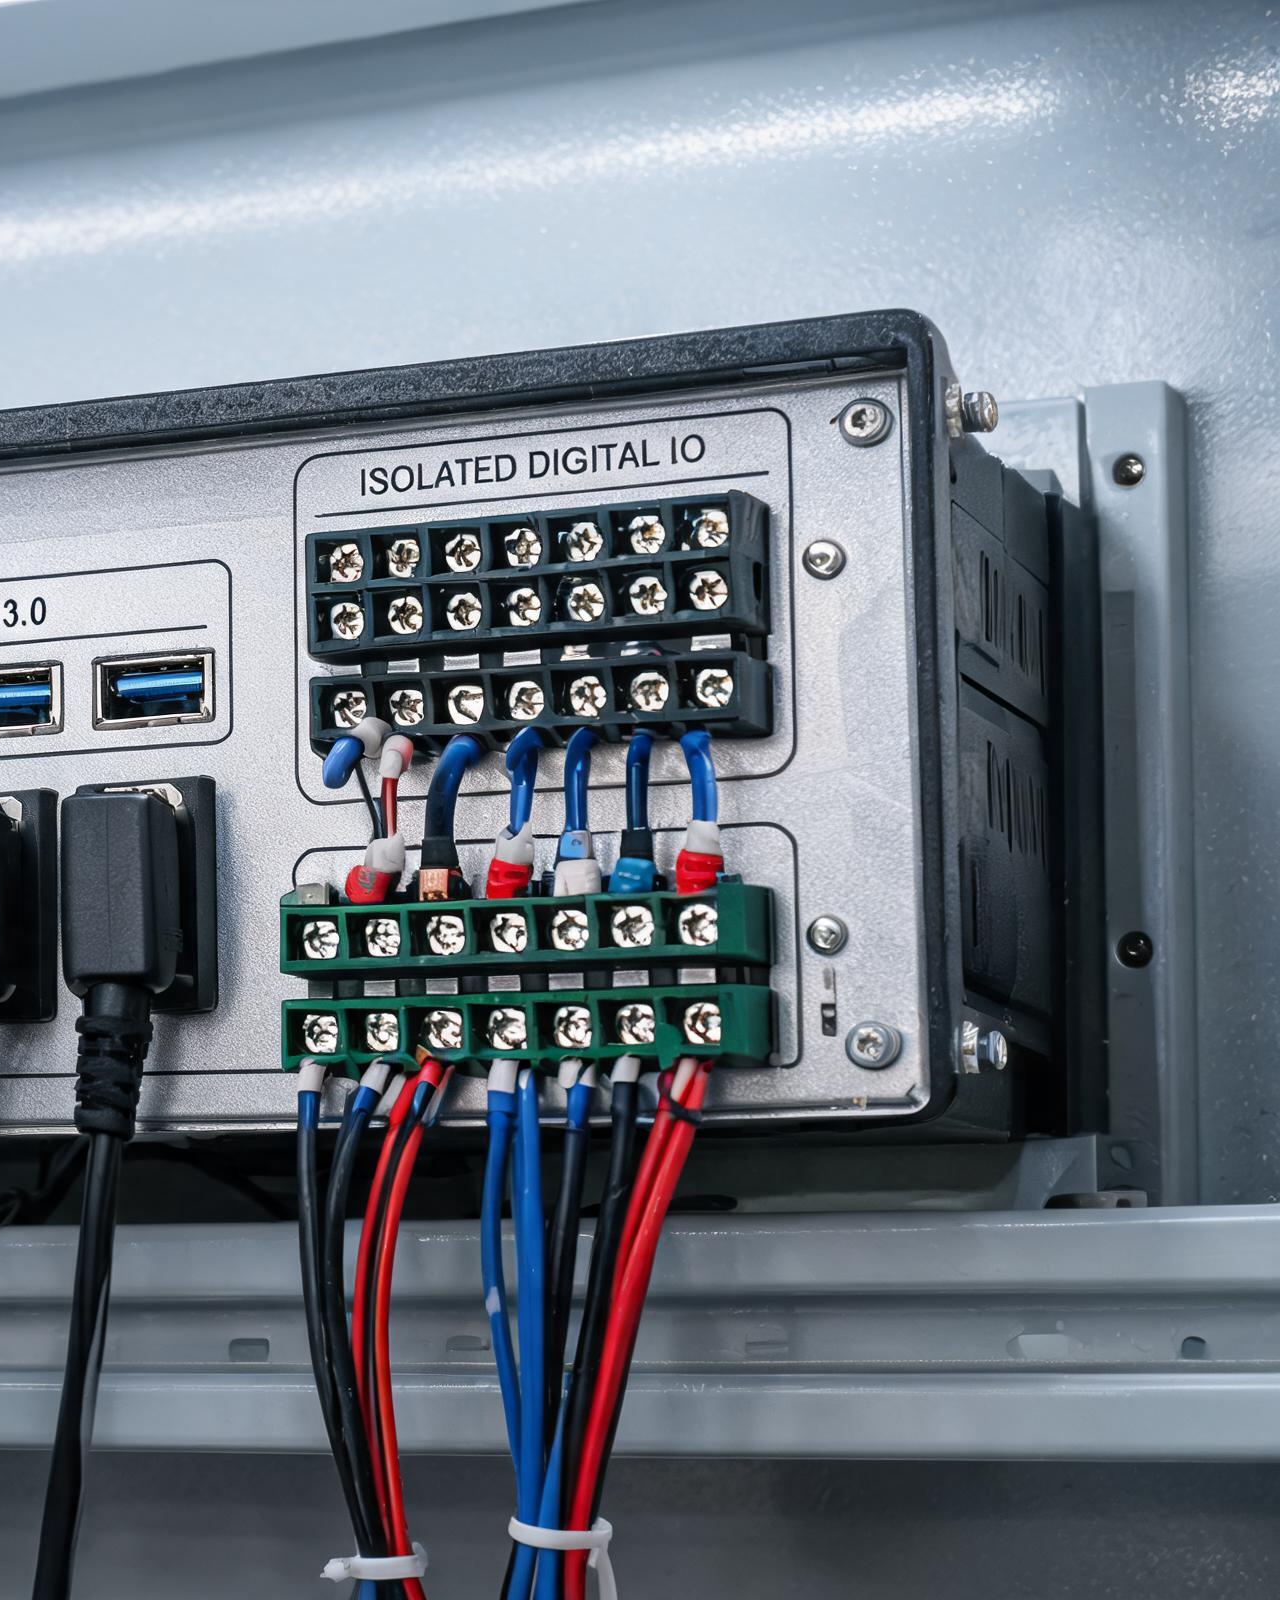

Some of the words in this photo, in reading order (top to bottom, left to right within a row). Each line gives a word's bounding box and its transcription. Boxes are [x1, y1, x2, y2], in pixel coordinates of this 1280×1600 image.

[360, 453, 517, 496] ISOLATED
[529, 439, 660, 479] DIGITAL
[671, 433, 706, 465] IO
[3, 596, 47, 628] 3.0
